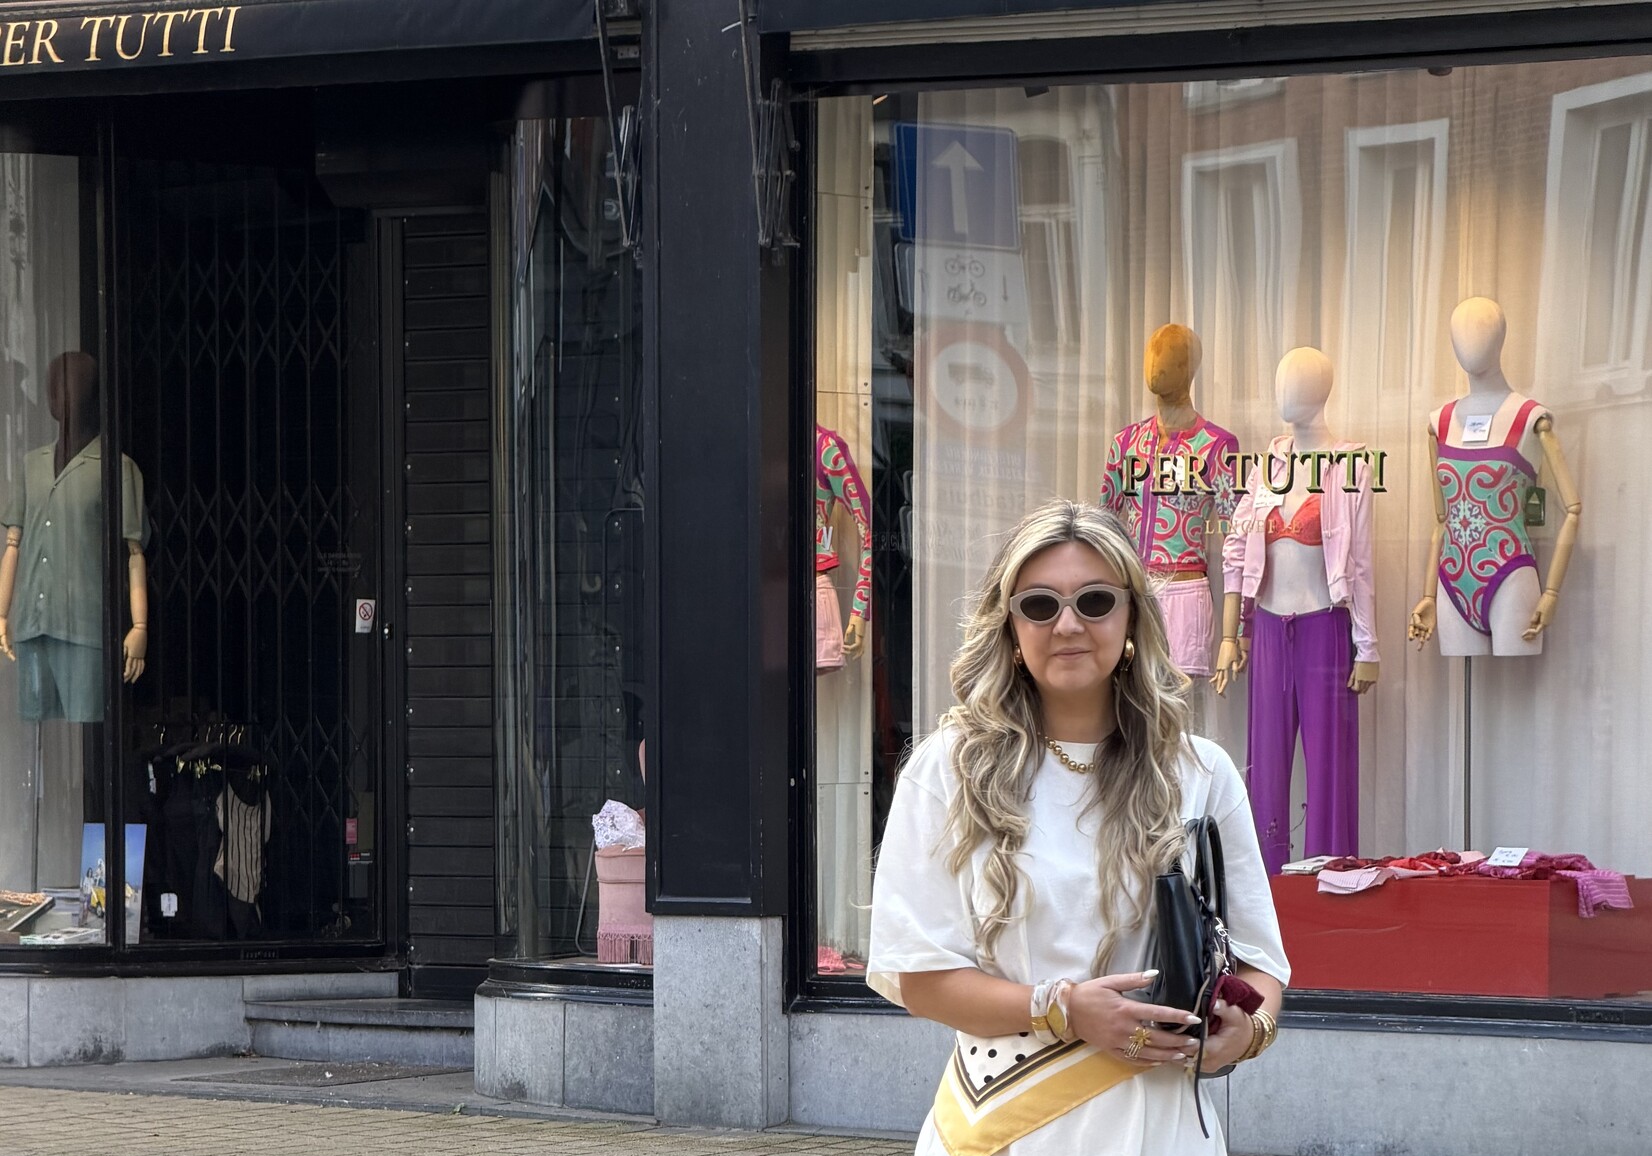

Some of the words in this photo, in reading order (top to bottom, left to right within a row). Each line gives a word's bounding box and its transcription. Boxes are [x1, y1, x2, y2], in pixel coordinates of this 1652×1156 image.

[0, 20, 64, 66] ER
[80, 6, 242, 62] TUTTI
[1122, 451, 1216, 496] PER
[1225, 451, 1388, 495] TUTTI
[1204, 519, 1303, 536] LINGERE
